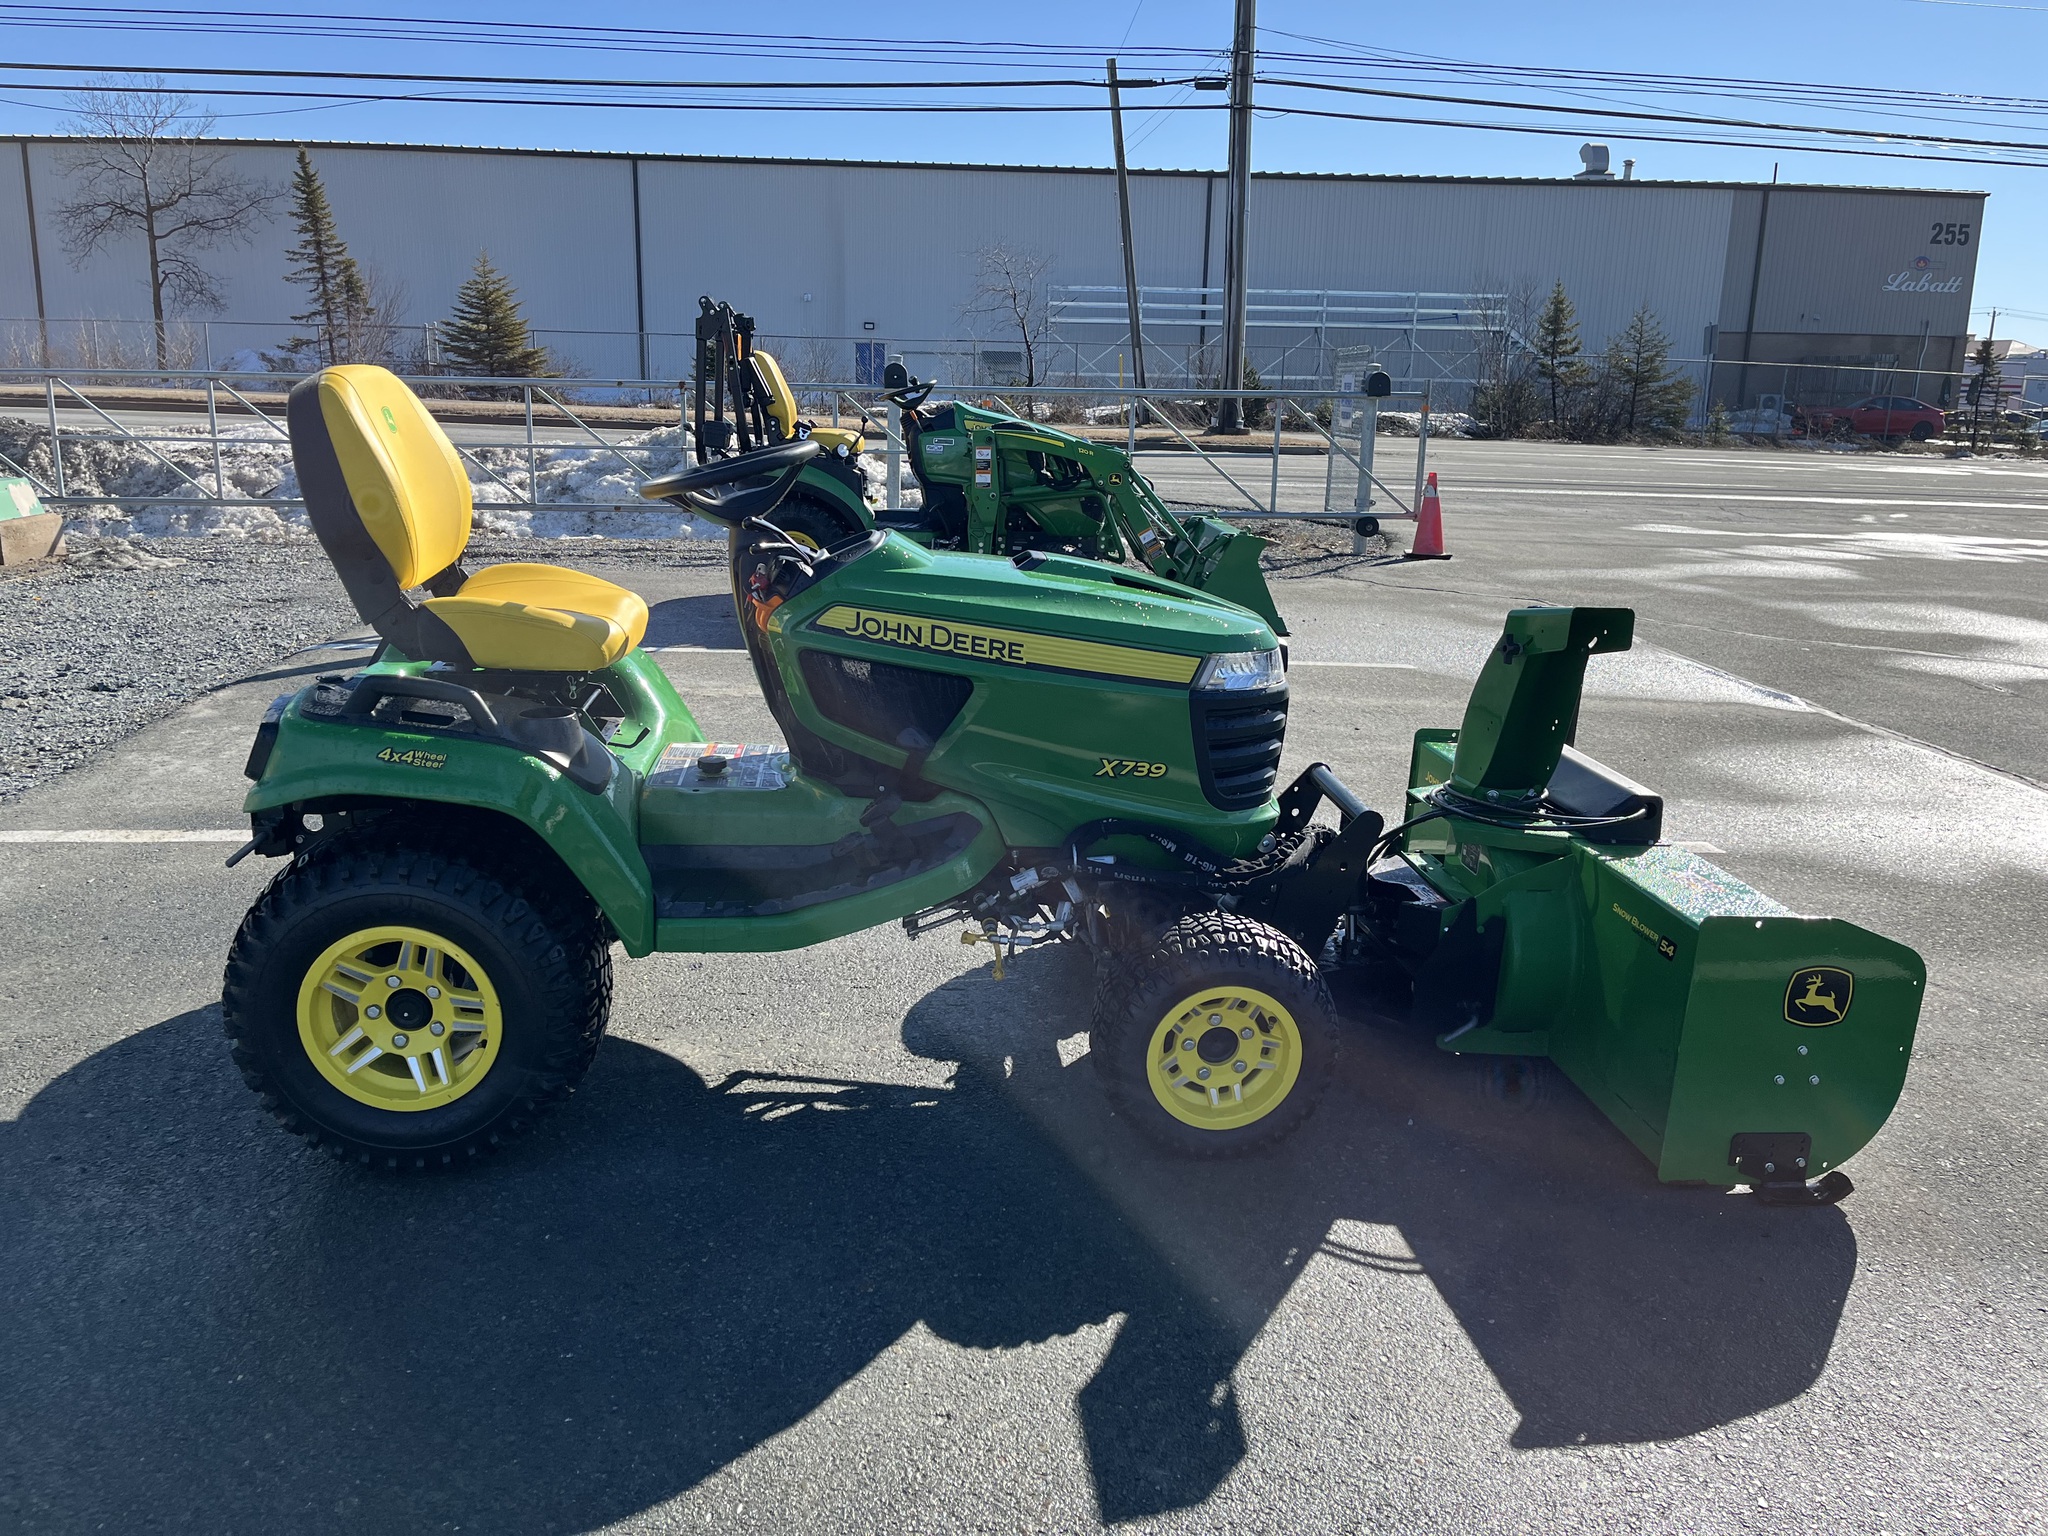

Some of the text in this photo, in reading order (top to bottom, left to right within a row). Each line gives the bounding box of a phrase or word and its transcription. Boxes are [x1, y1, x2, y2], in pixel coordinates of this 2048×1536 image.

[1929, 222, 1970, 246] 255
[1881, 270, 1963, 293] Labatt
[845, 611, 1025, 662] JOHN DEERE
[377, 747, 447, 764] 4x4 Wheel
[412, 758, 444, 769] Steer
[1094, 758, 1168, 778] X739
[1612, 902, 1632, 922] SNOW
[1630, 916, 1659, 942] BLOWER
[1659, 939, 1675, 957] 54
